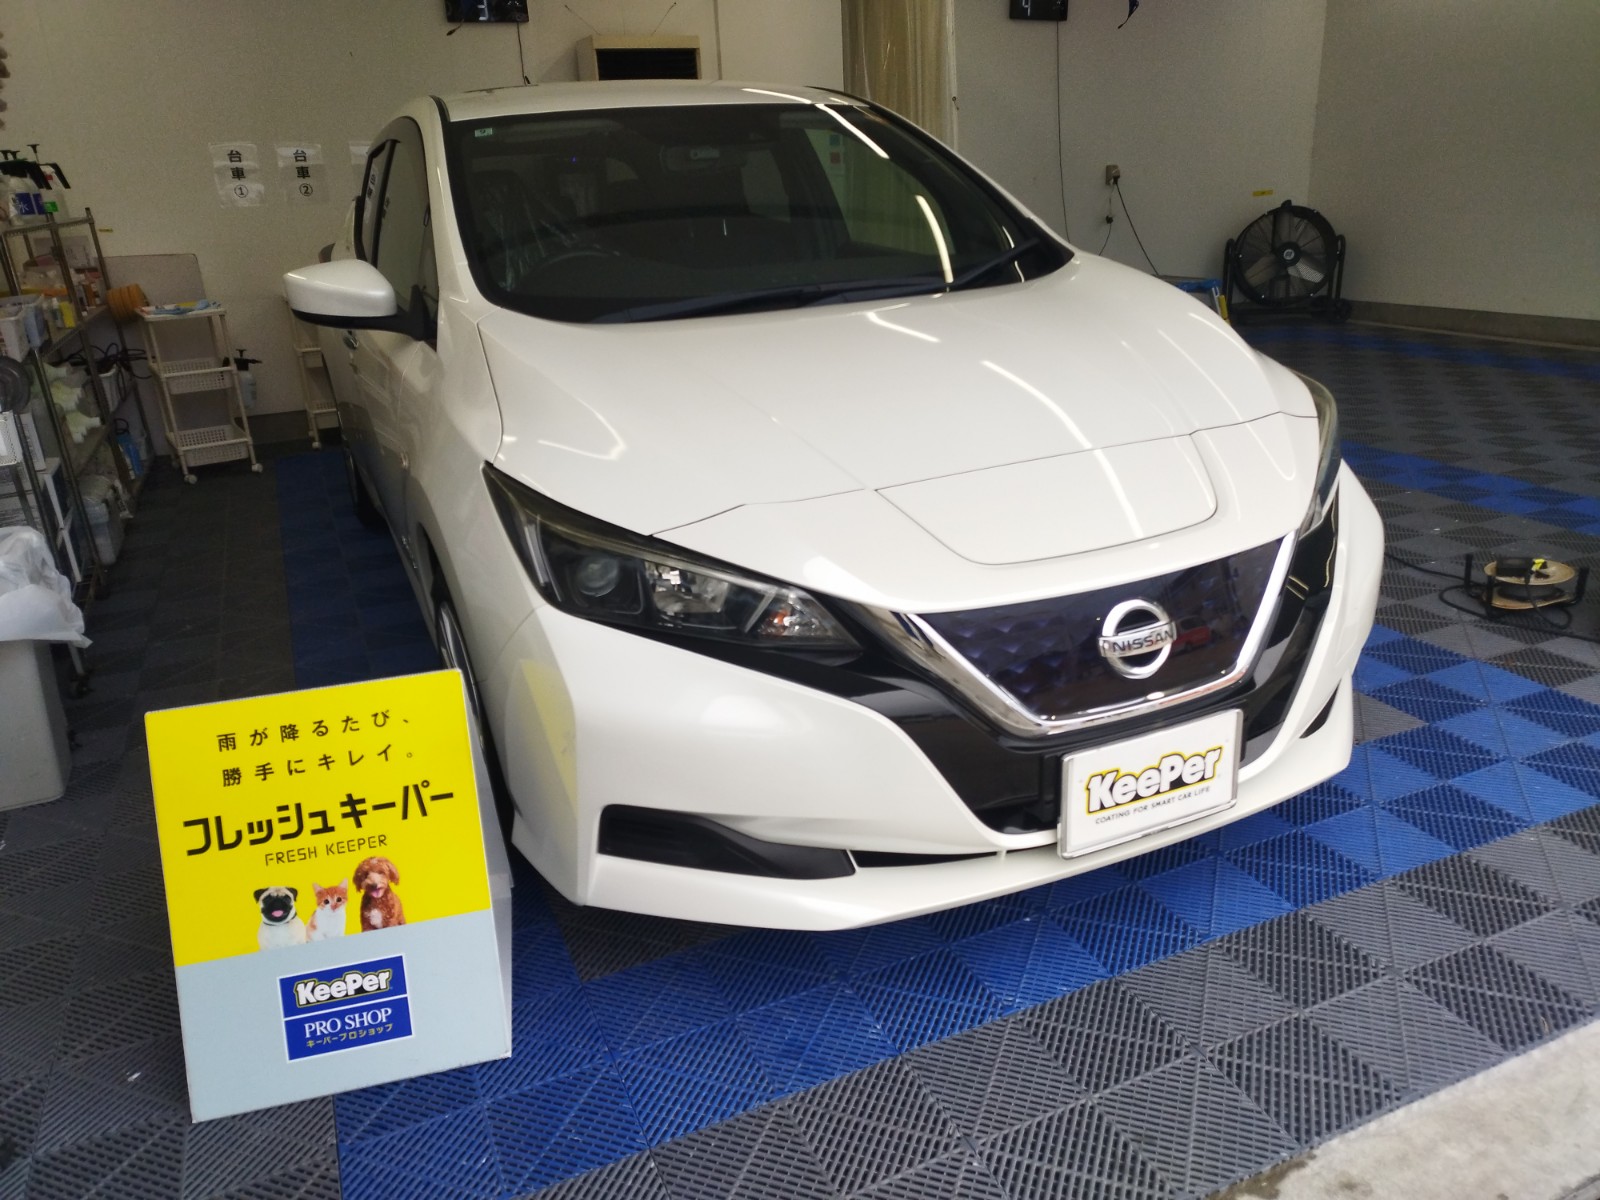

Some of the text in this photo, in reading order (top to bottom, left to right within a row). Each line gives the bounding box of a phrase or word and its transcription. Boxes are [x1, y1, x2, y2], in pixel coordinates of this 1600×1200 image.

[1112, 630, 1174, 653] NISSAN
[216, 710, 410, 753] 雨が降るたび、
[222, 744, 413, 788] 勝手にキレイ。
[1087, 746, 1222, 814] KeePer
[183, 779, 454, 857] フレッシュキーパー
[1095, 786, 1210, 825] COATING FOR SMART CAR LIFE
[265, 834, 388, 866] FRESH KEEPER
[294, 969, 392, 1007] KeePer
[304, 1007, 392, 1038] PRO SHOP
